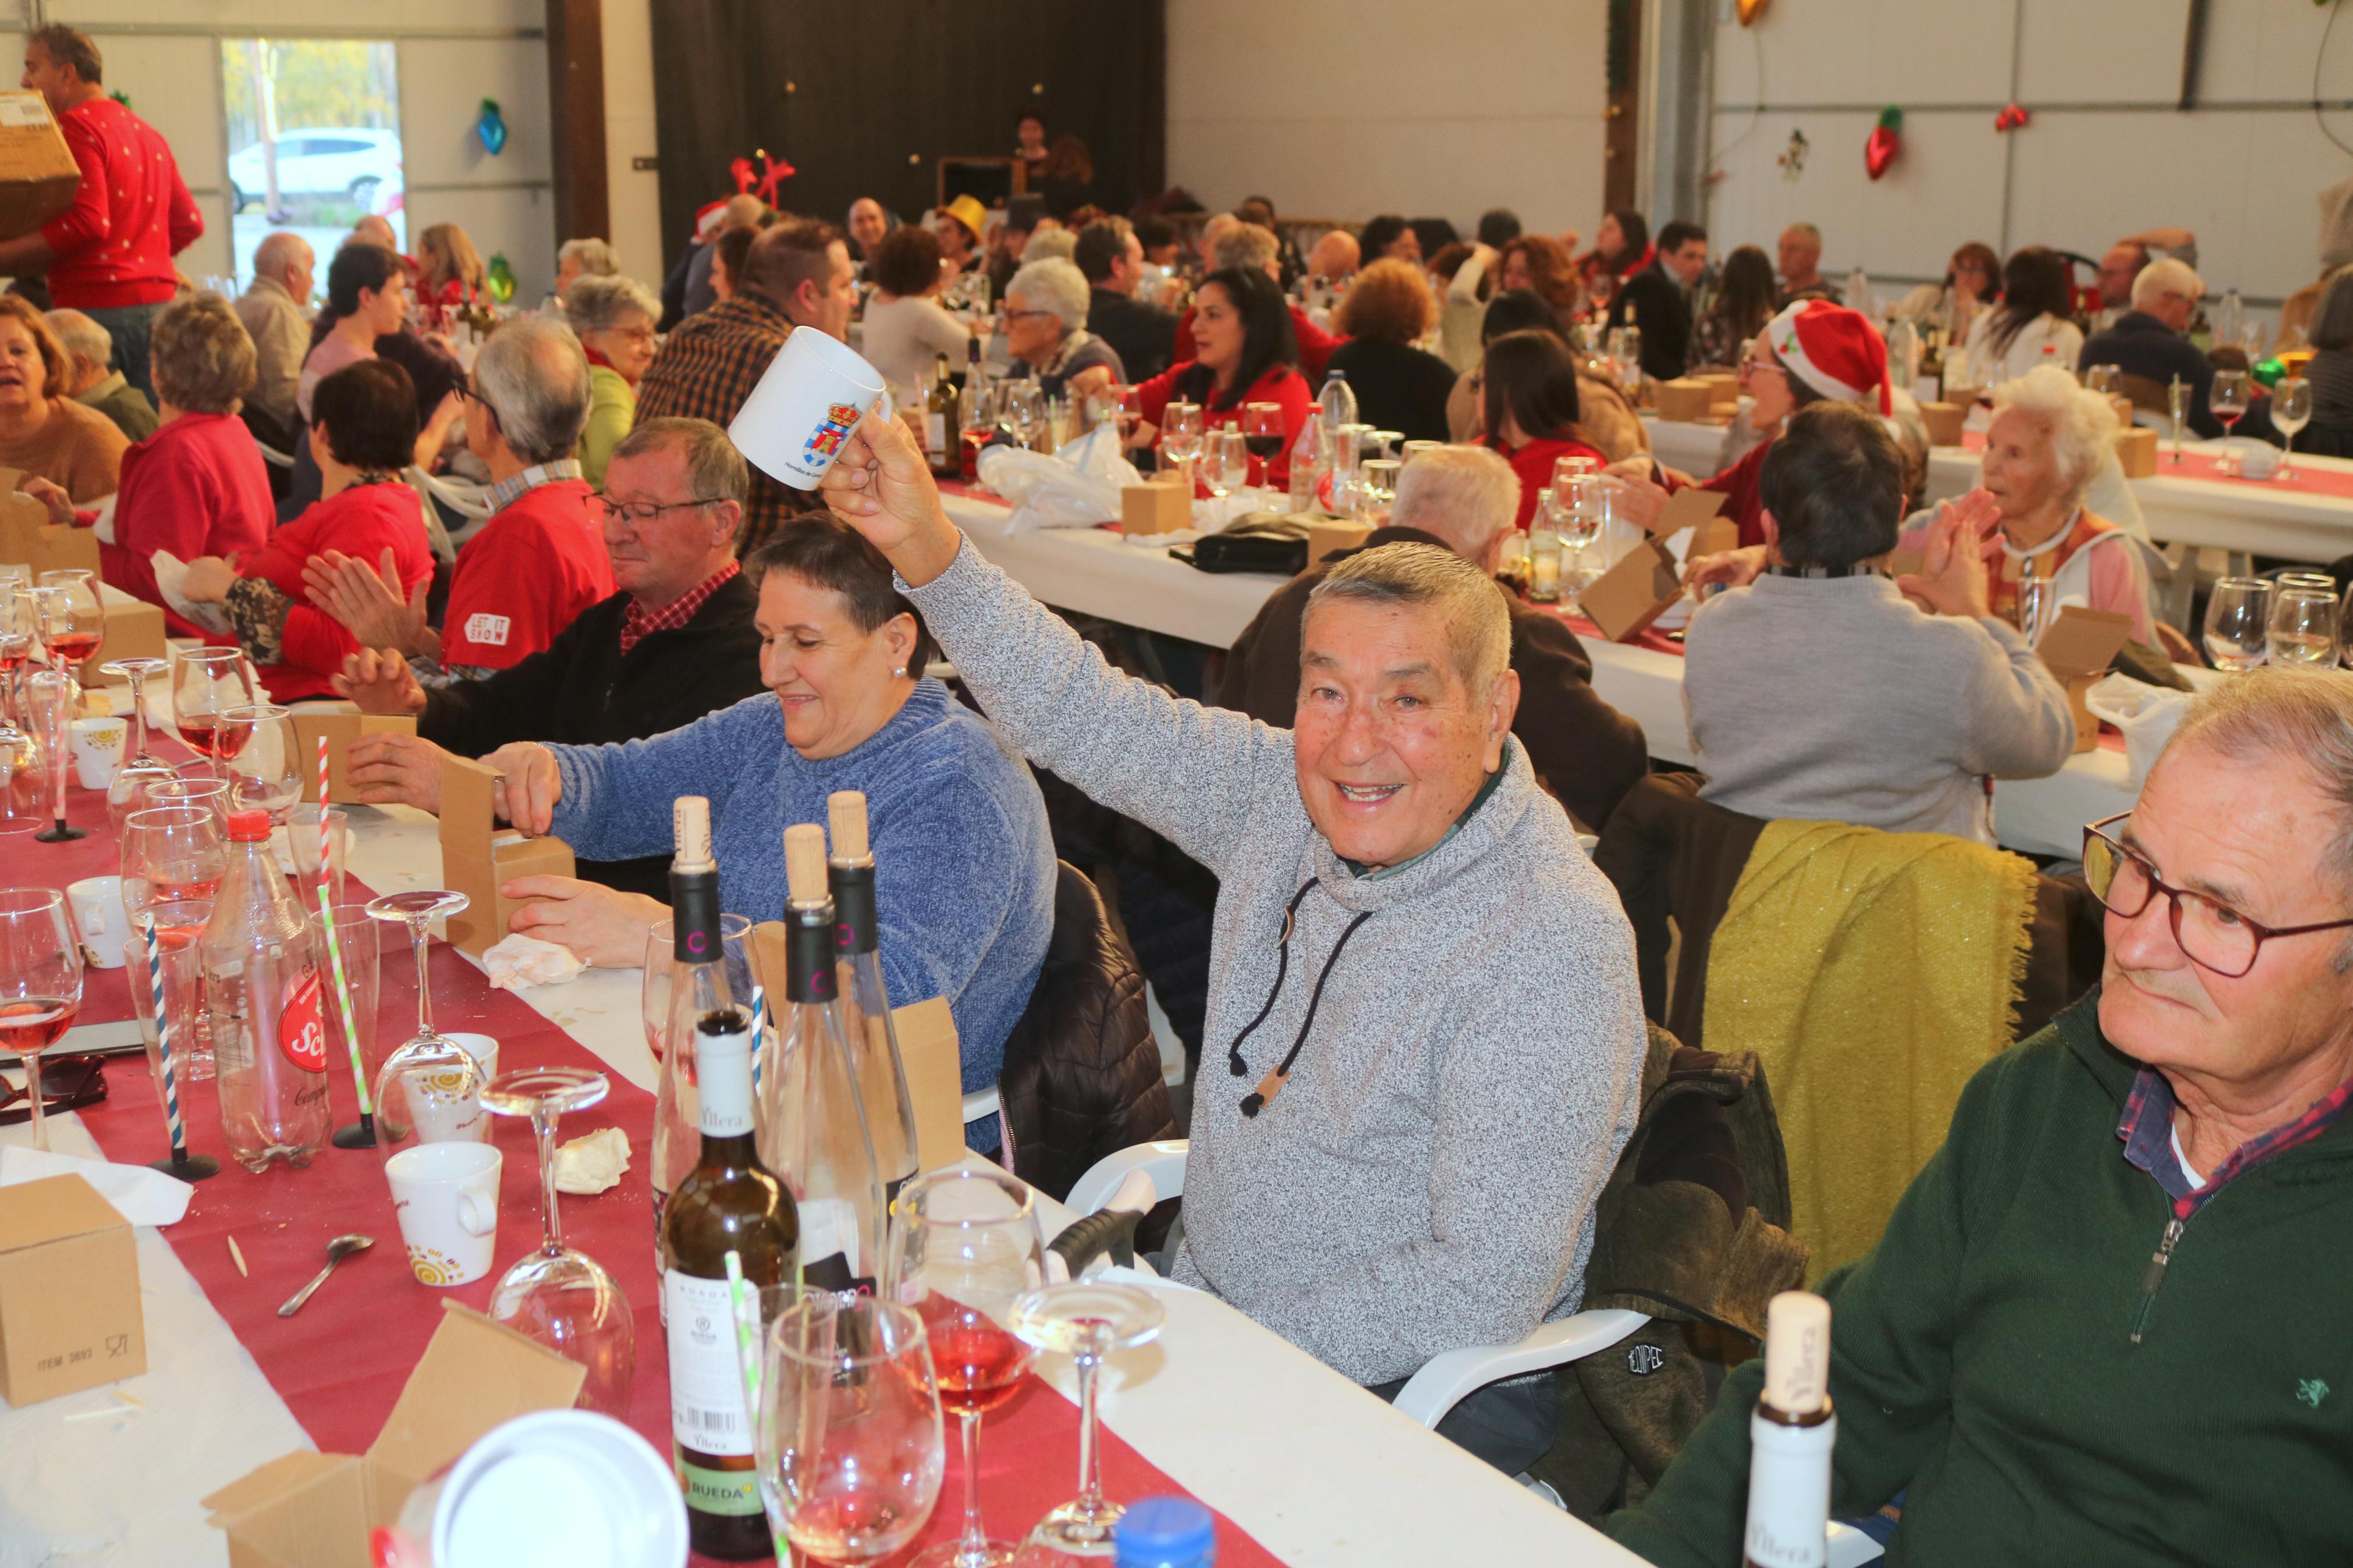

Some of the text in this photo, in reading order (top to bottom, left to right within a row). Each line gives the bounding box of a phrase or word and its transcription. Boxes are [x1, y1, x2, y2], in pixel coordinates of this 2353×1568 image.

[472, 616, 506, 630] LET IT
[37, 1355, 63, 1371] ITEM
[692, 1483, 744, 1499] RUEDA
